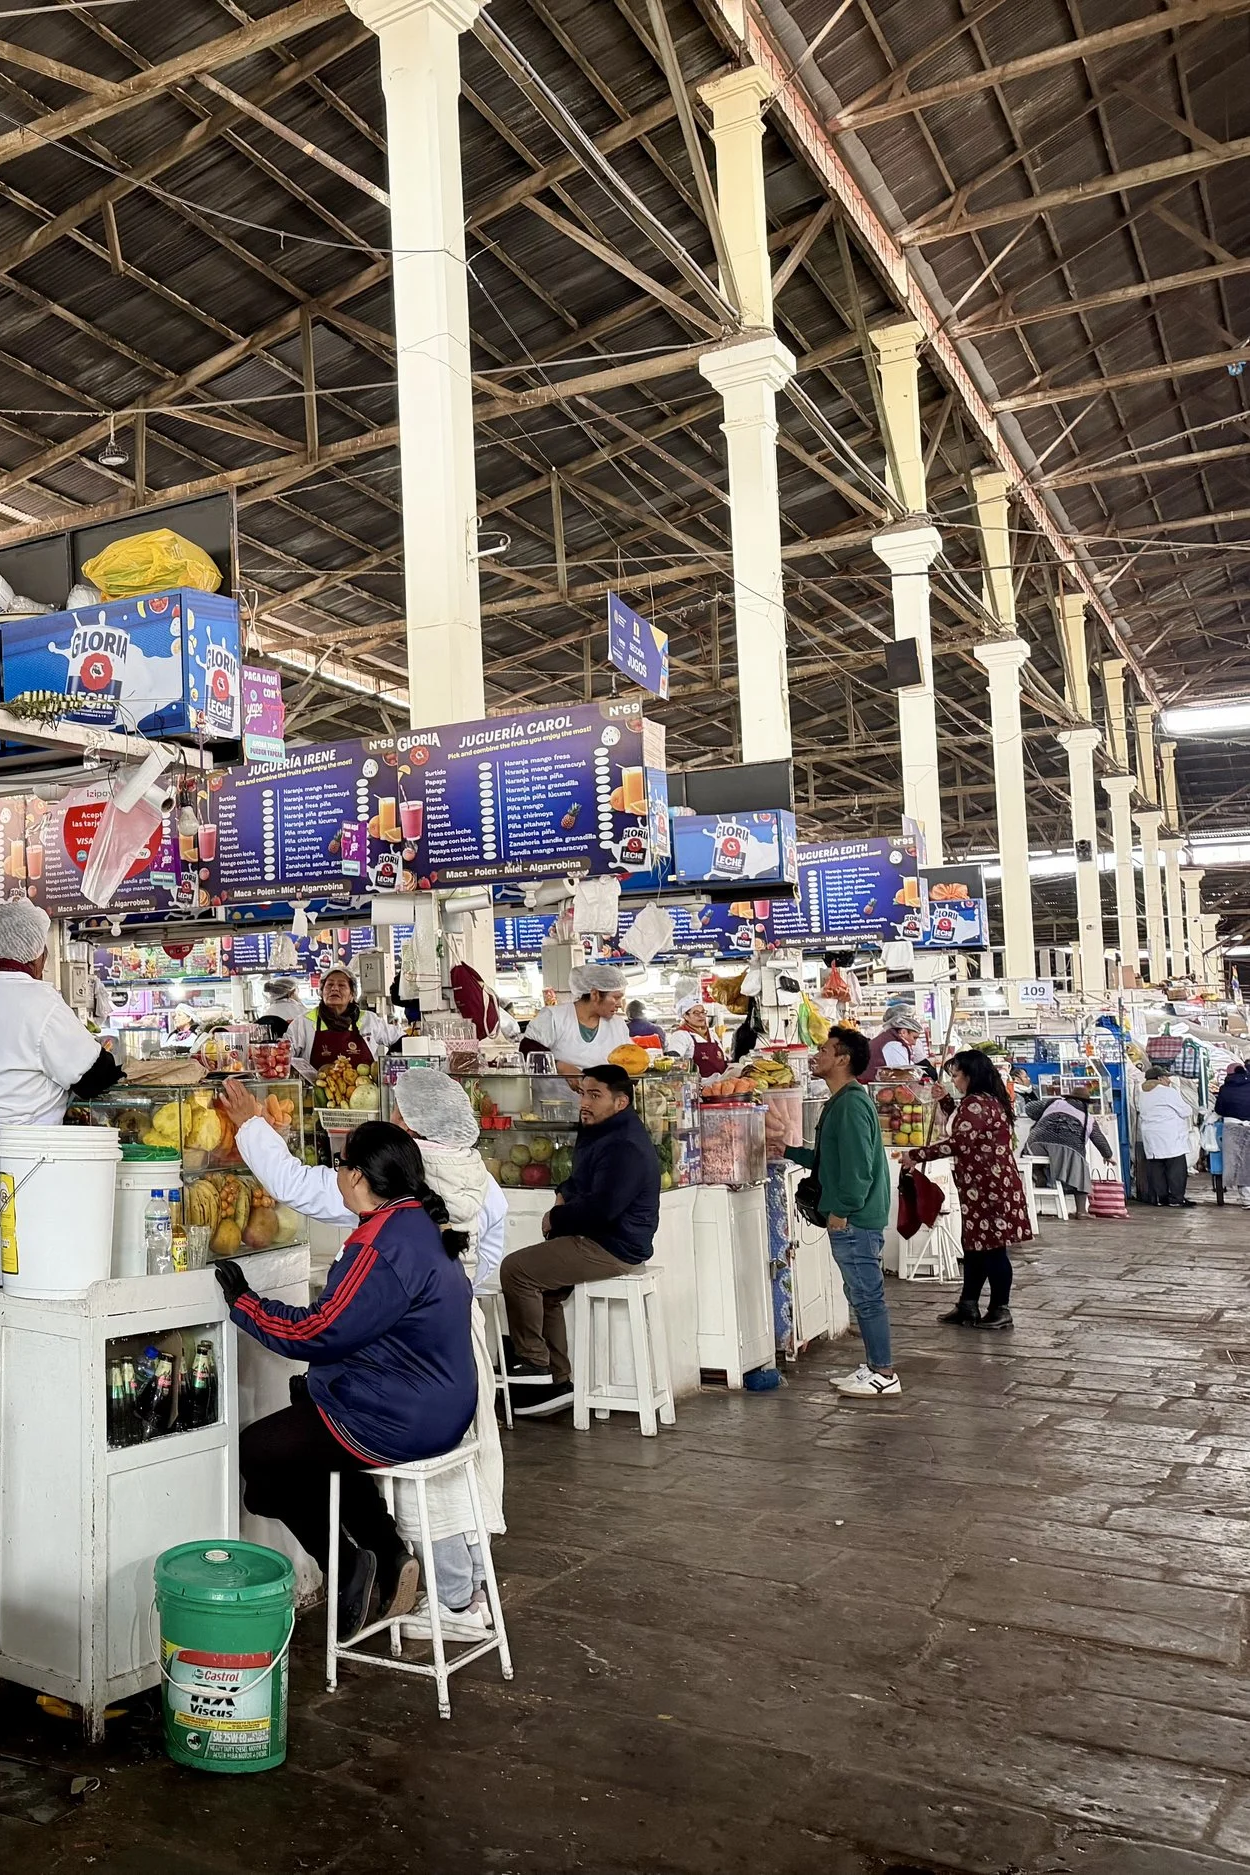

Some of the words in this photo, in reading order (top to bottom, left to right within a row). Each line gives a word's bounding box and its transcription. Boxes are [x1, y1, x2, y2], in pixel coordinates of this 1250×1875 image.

[72, 632, 128, 664] GLORIA
[206, 649, 236, 677] GLORIA
[627, 656, 647, 679] JUGOS
[244, 670, 260, 685] PAGA
[260, 673, 278, 686] AQUÍ
[263, 688, 276, 698] CON
[207, 698, 231, 719] LECHE
[397, 733, 440, 752] GLORIA
[459, 723, 524, 748] JUGUERÍA
[527, 716, 572, 735] CAROL
[461, 750, 472, 758] and
[473, 745, 499, 755] combine
[500, 742, 510, 750] the
[511, 739, 528, 748] fruits
[530, 737, 542, 746] you
[543, 732, 561, 744] enjoy
[562, 729, 572, 738] the
[573, 726, 591, 736] most!
[248, 753, 301, 776] JUGUERÍA
[304, 750, 336, 765] IRENE
[301, 768, 312, 776] you
[313, 765, 327, 775] enjoy
[82, 812, 103, 821] Acept
[86, 820, 102, 828] tarj
[717, 824, 749, 844] GLORIA
[622, 851, 644, 860] LECHE
[840, 844, 868, 855] EDITH
[716, 854, 742, 868] LECHE
[446, 870, 468, 879] Maca
[475, 867, 497, 876] Polen
[505, 863, 522, 873] Miel
[529, 861, 581, 872] Algarrobina
[234, 890, 251, 898] Maca
[257, 887, 276, 896] Polen
[281, 885, 296, 894] Miel
[301, 883, 343, 893] Algarrobina
[114, 899, 149, 909] Algarrobina
[1024, 986, 1045, 996] 109
[157, 1222, 171, 1231] CIE
[204, 1670, 239, 1682] Castrol
[190, 1704, 233, 1718] Viscus
